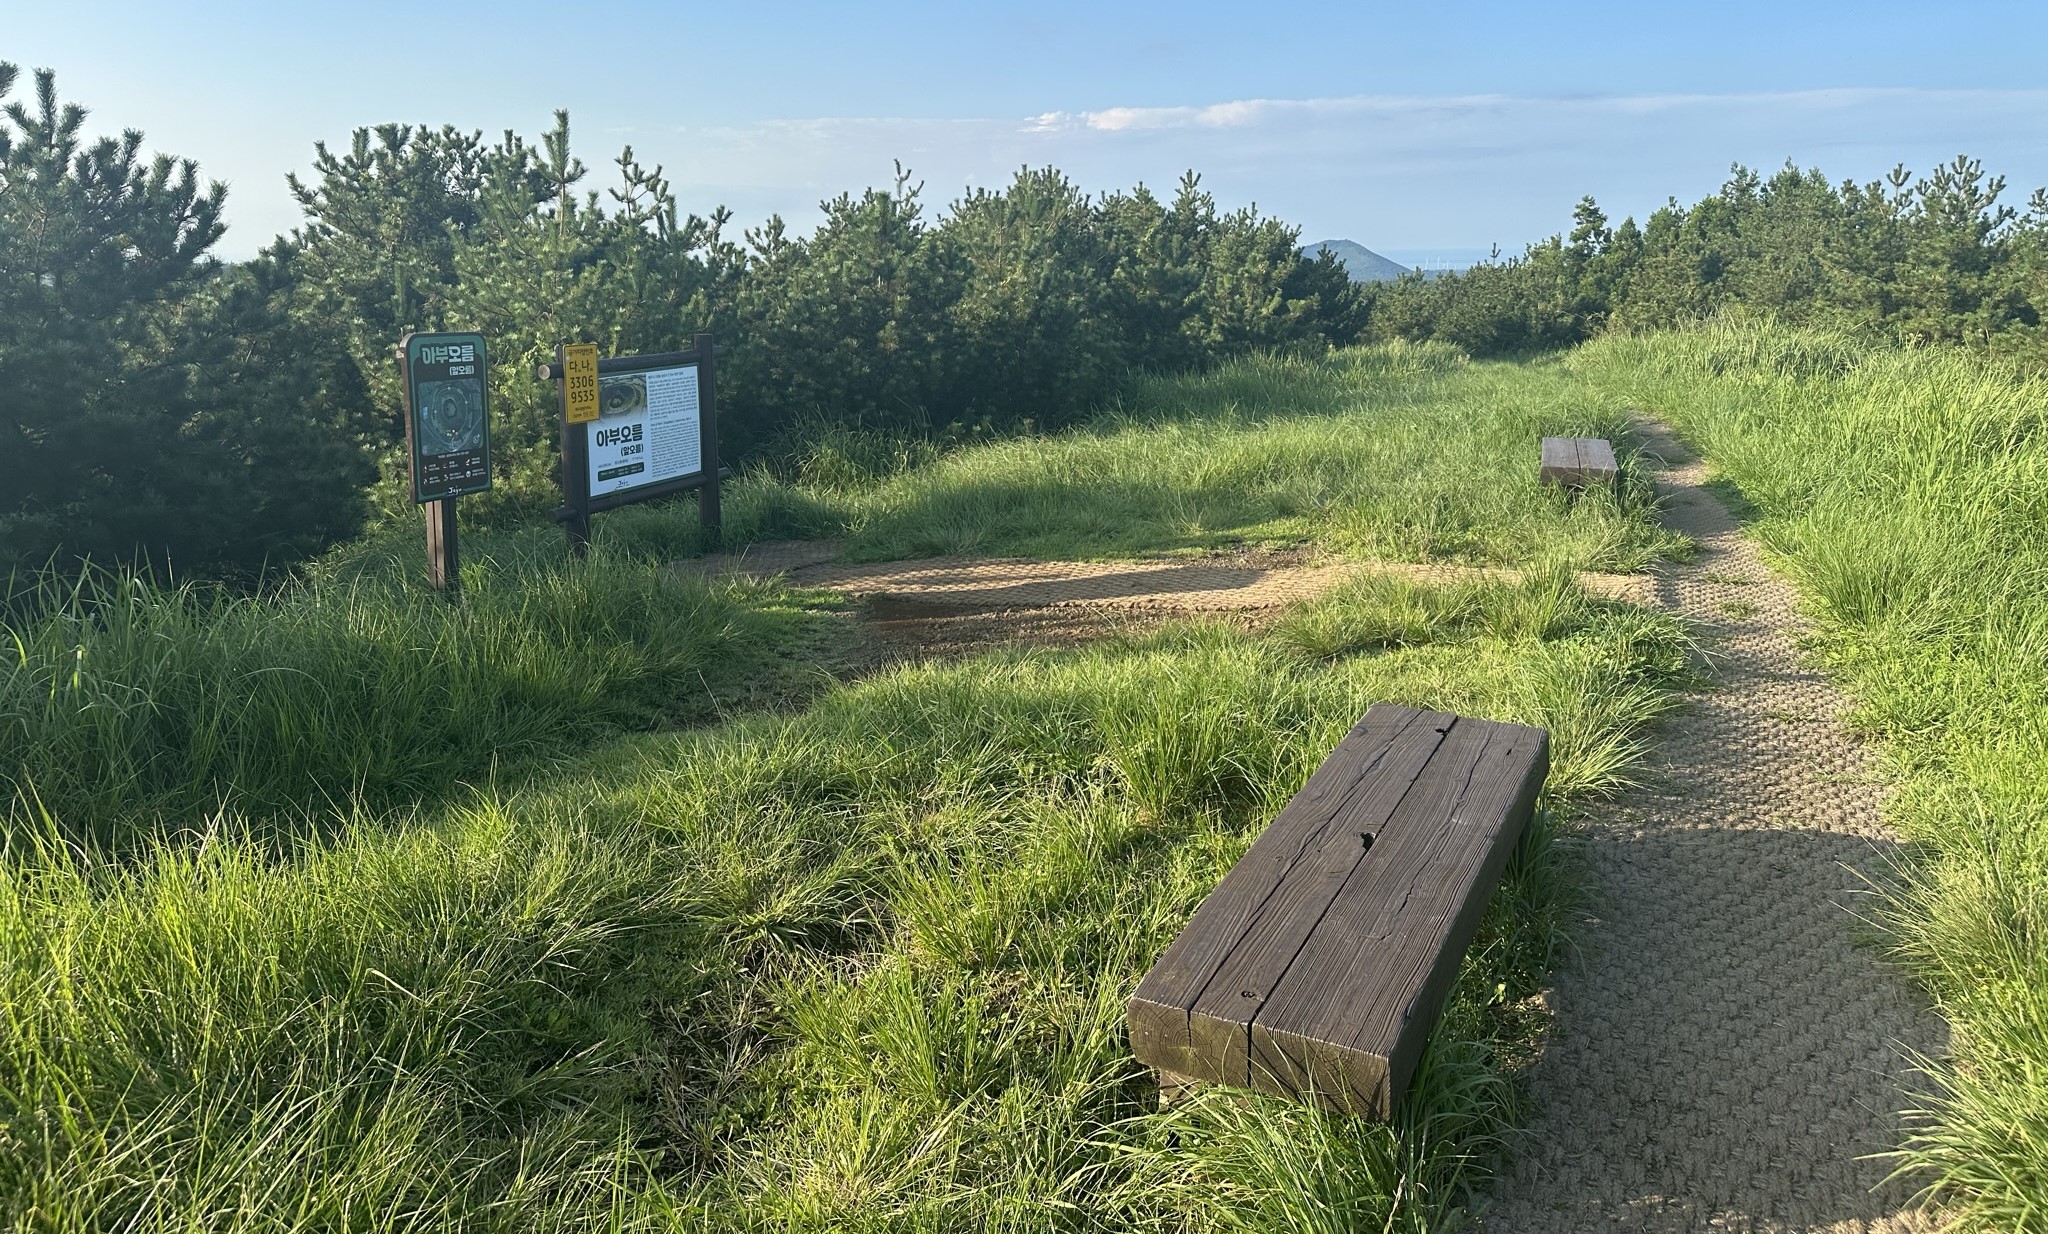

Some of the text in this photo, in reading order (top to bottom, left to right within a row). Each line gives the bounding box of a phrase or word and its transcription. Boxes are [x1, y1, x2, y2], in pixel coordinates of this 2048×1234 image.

[421, 345, 474, 365] 아부오름
[570, 375, 594, 389] 3306
[571, 390, 595, 404] 9535
[596, 423, 643, 447] 아부오름
[620, 443, 644, 456] (앞오름)
